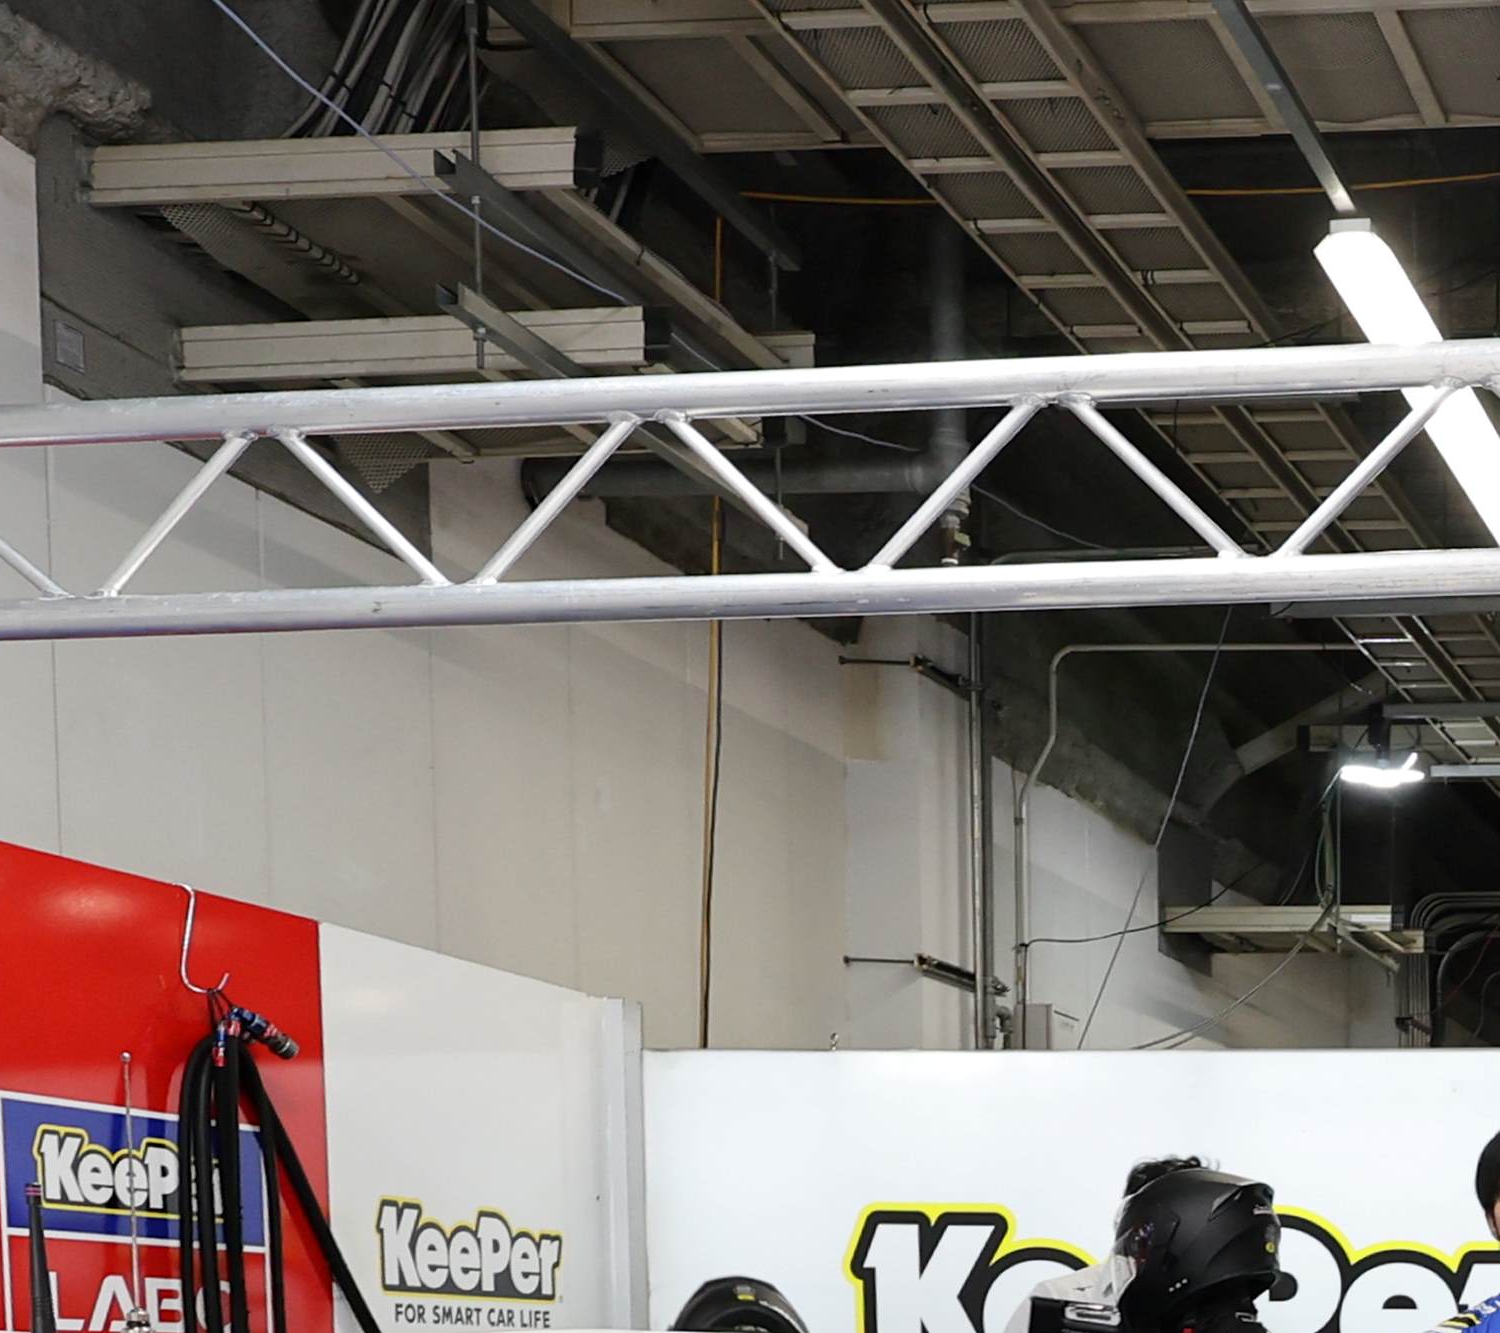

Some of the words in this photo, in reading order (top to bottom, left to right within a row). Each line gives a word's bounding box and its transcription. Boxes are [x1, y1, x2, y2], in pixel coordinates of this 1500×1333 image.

[36, 1128, 227, 1217] KeeP
[376, 1199, 563, 1299] KeePer
[394, 1303, 427, 1325] FOR
[431, 1307, 483, 1327] SMART
[486, 1308, 516, 1328] CAR
[519, 1309, 552, 1329] LIFE
